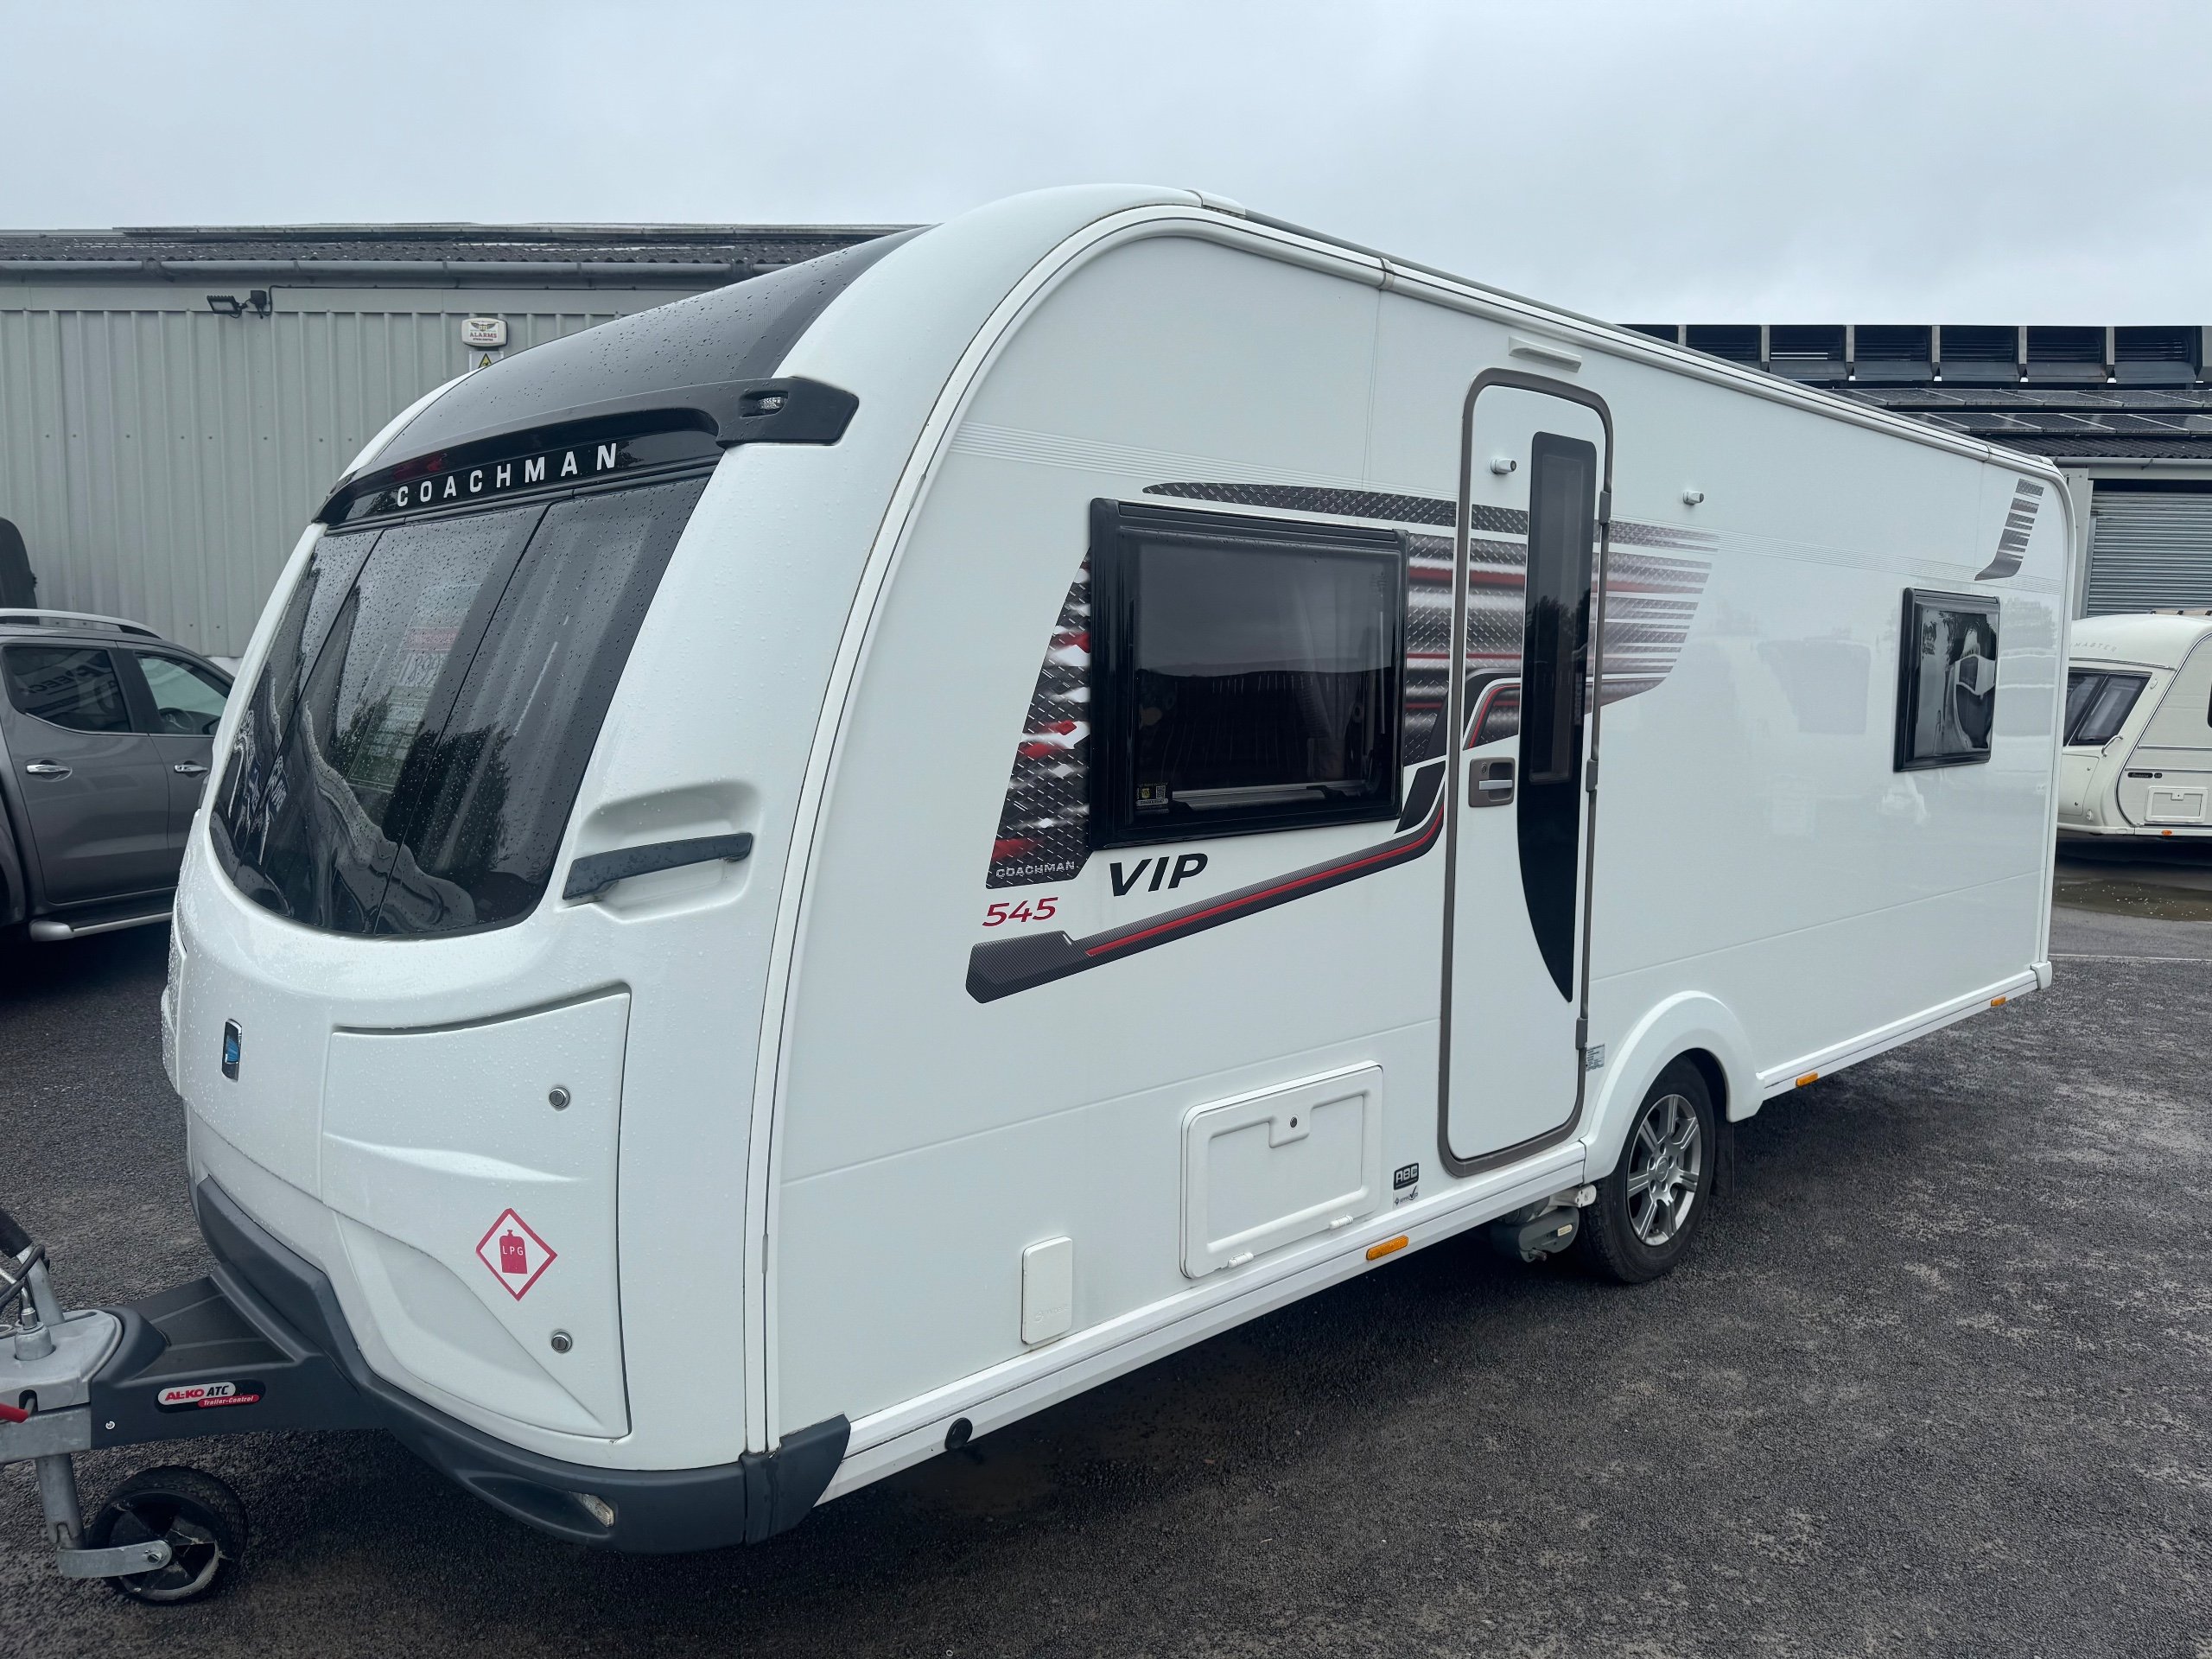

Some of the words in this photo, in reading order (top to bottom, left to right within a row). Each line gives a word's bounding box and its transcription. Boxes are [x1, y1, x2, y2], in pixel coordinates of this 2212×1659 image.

[397, 442, 618, 508] COACHMAN
[2070, 642, 2117, 652] MASTER
[995, 860, 1076, 879] COACHMAN
[1109, 852, 1209, 898] VIP
[982, 896, 1059, 927] 545
[1395, 1165, 1418, 1184] ABC
[207, 1385, 230, 1397] ATC
